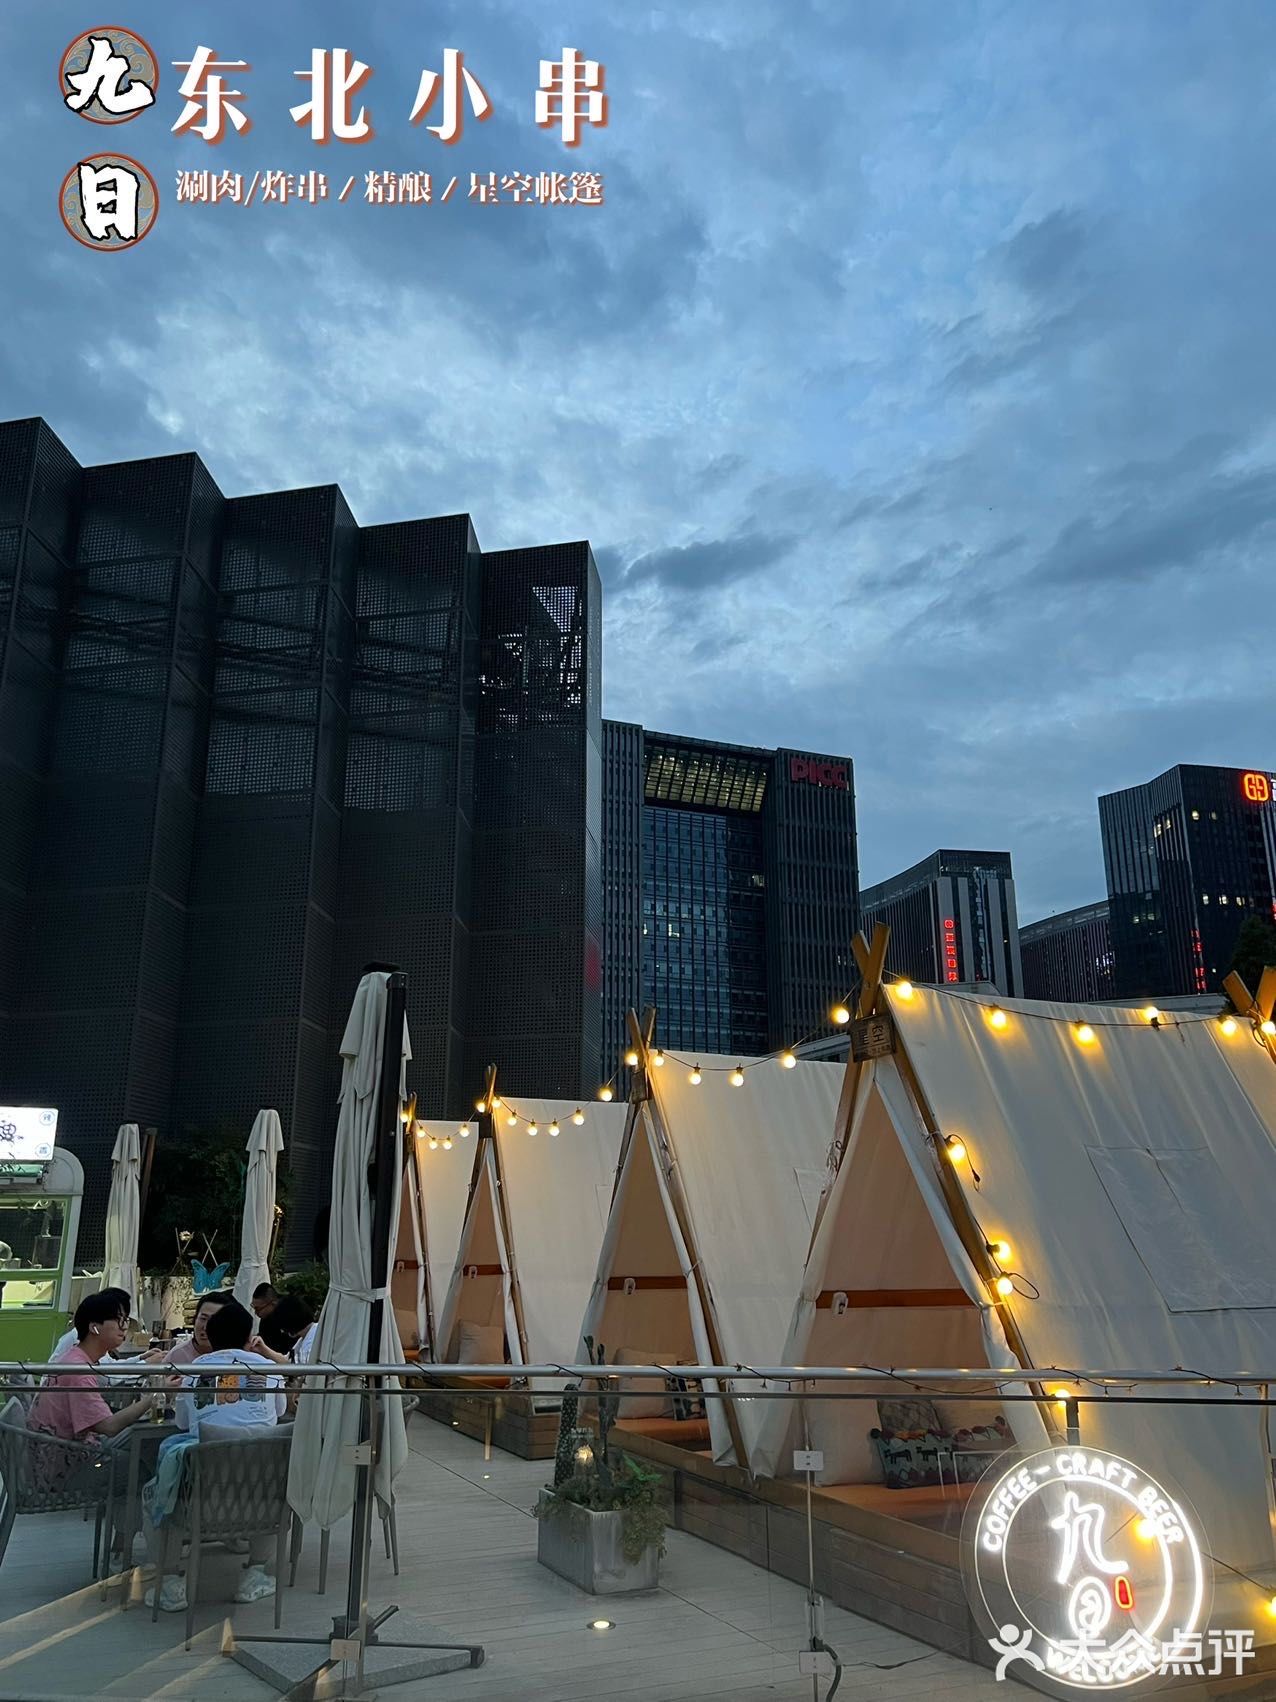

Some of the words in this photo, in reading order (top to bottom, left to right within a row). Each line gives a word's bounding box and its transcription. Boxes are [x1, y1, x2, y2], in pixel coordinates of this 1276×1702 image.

[791, 757, 848, 789] PICC
[981, 1468, 1039, 1553] COFFEE
[1055, 1453, 1138, 1489] CRAFT
[1138, 1486, 1185, 1545] BEER
